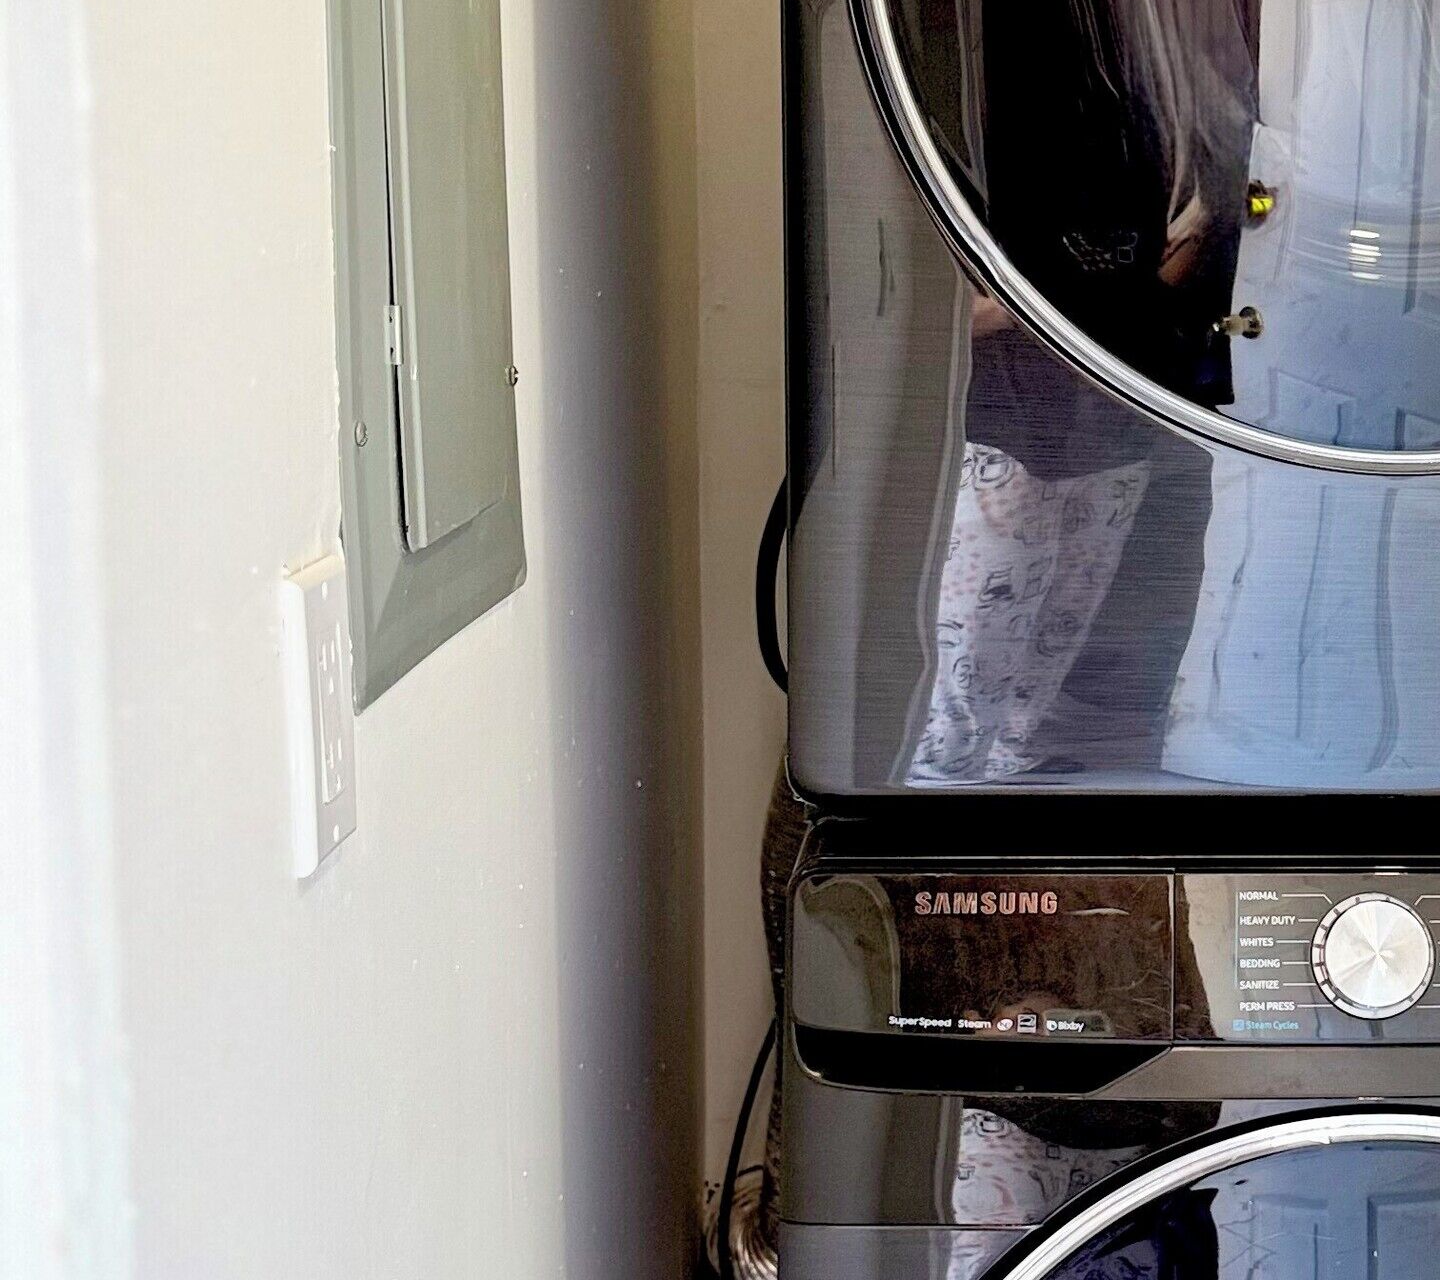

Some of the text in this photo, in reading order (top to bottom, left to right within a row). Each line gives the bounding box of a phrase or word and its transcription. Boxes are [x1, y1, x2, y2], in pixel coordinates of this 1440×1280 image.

[1239, 891, 1279, 901] NORMAL
[915, 891, 1058, 915] SAMSUNG
[1240, 915, 1296, 925] HEAVY DUTY
[1239, 937, 1274, 947] WHITES
[1239, 958, 1281, 968] BEDDING
[1239, 979, 1280, 990] SANITIZE
[1239, 1001, 1296, 1011] PERM PRESS
[957, 1019, 991, 1029] Steam
[1245, 1020, 1299, 1030] Steam Cycles
